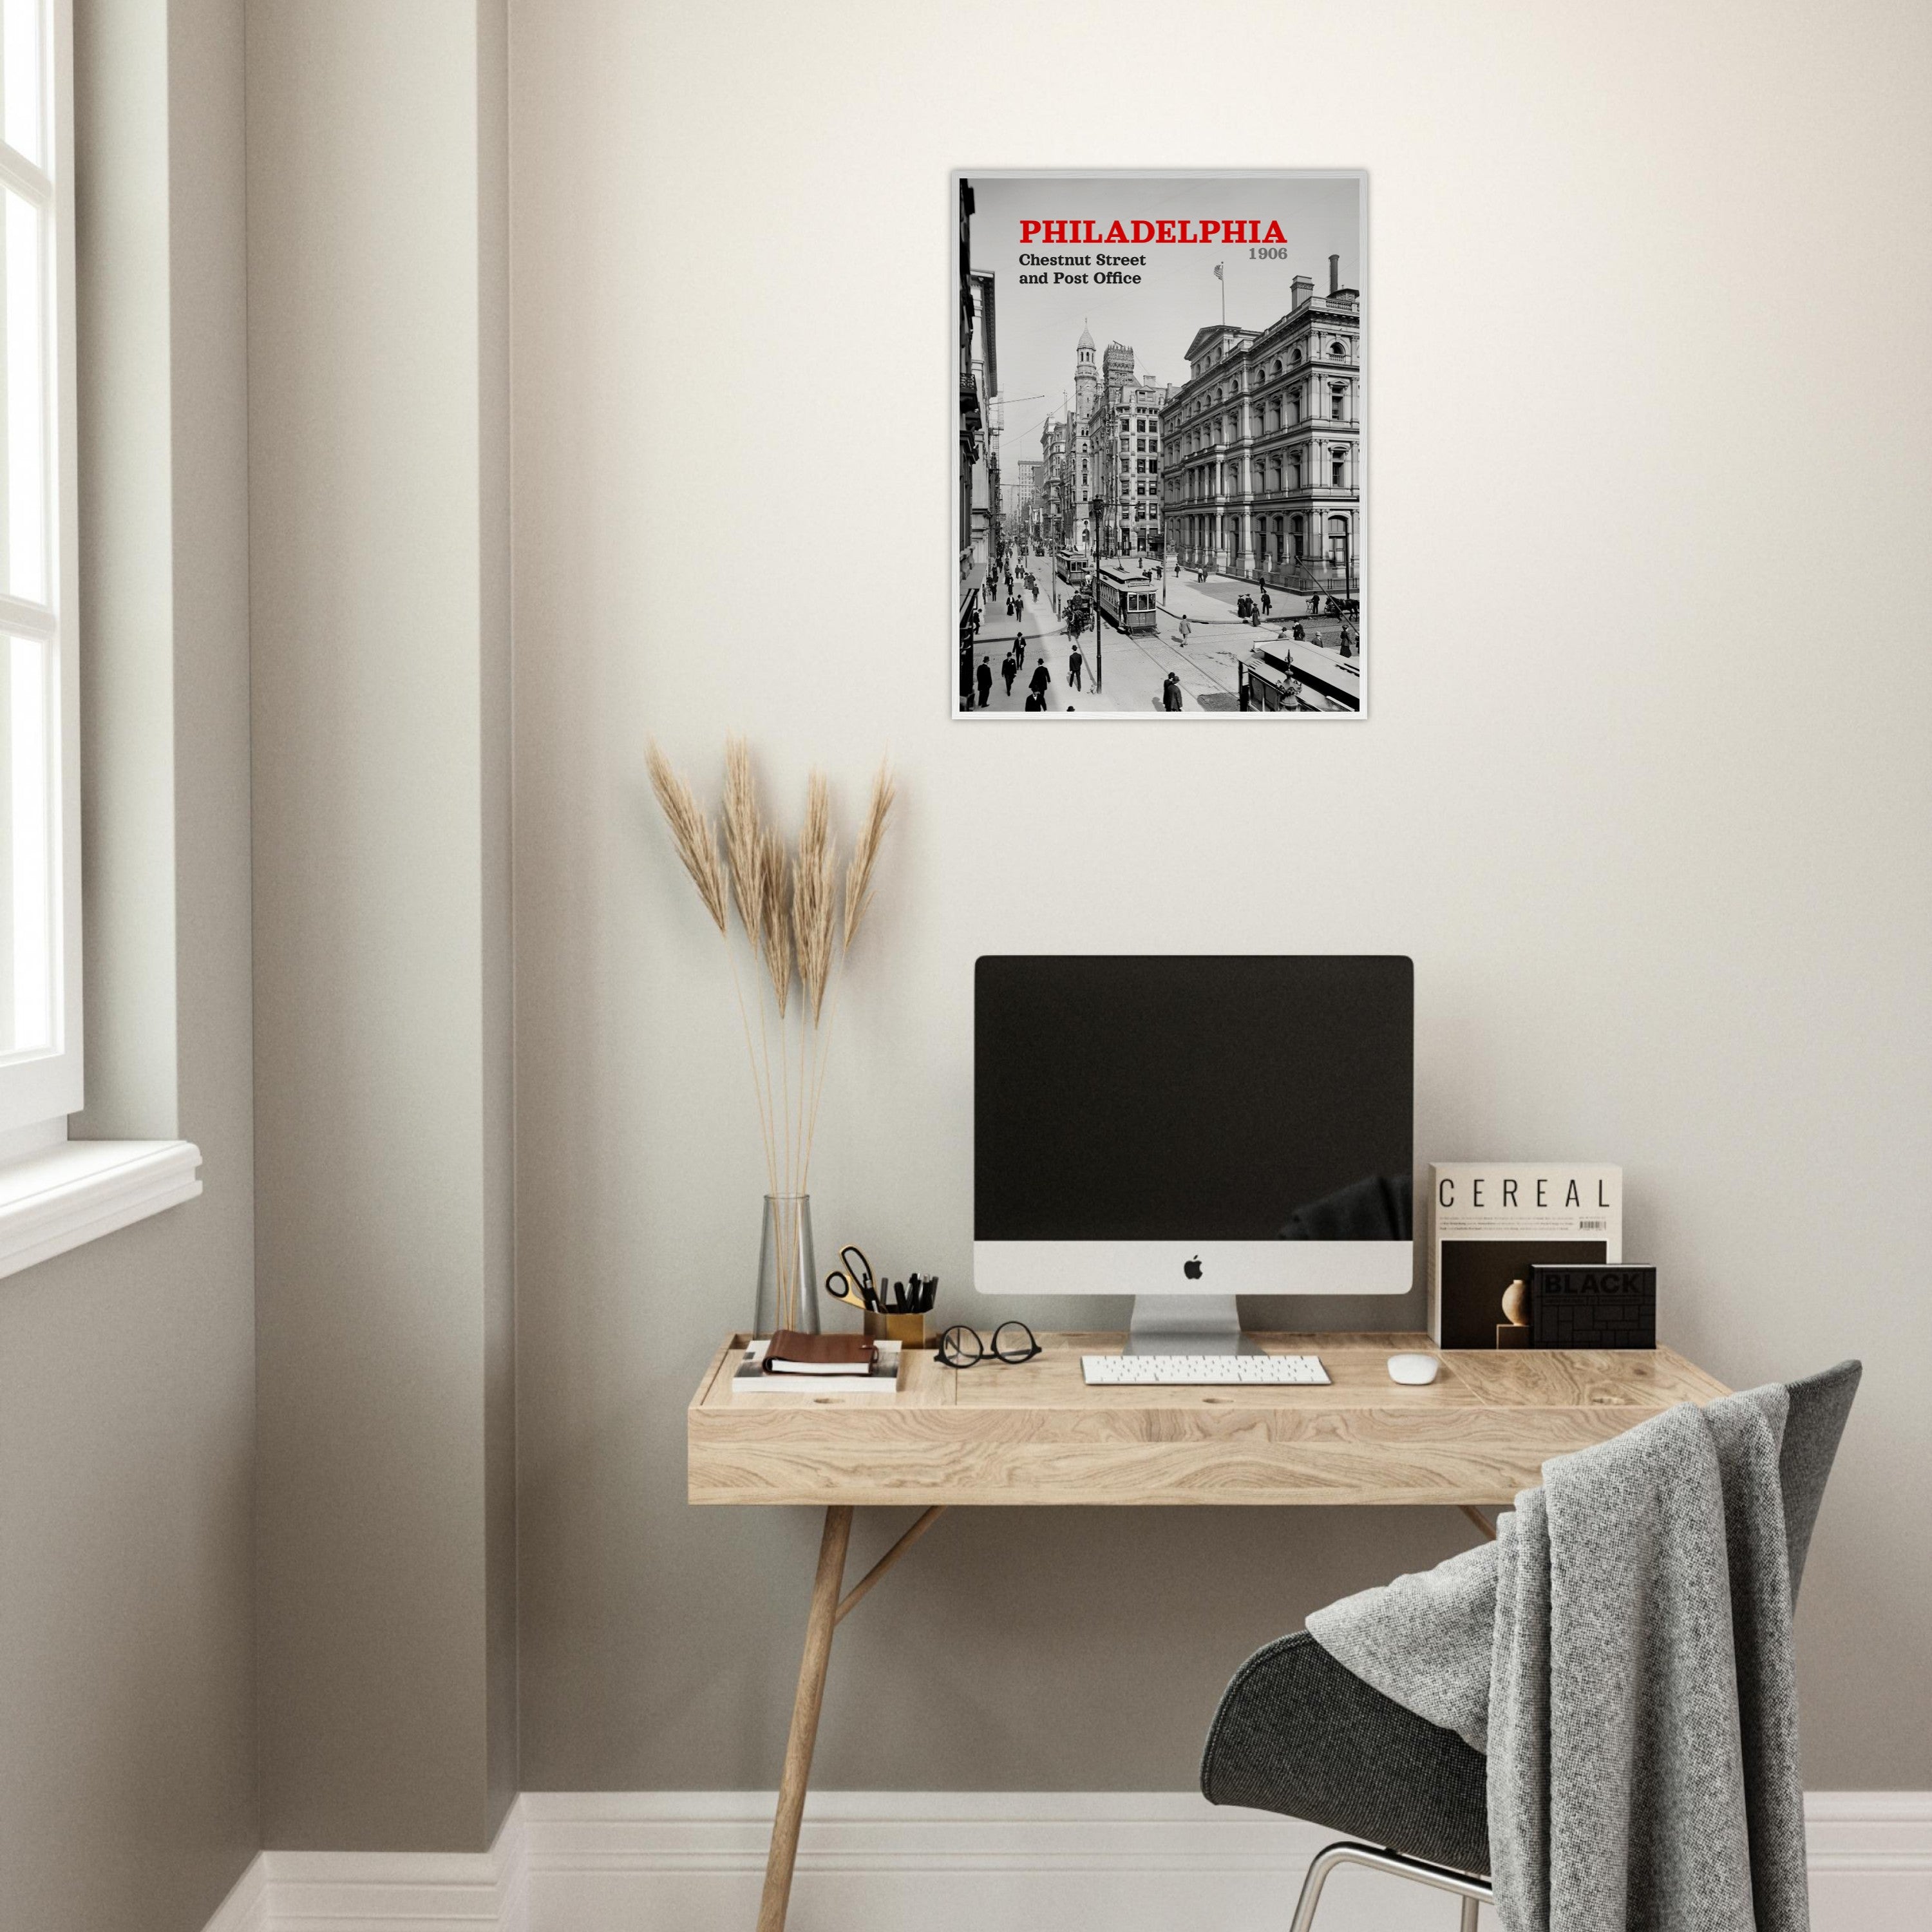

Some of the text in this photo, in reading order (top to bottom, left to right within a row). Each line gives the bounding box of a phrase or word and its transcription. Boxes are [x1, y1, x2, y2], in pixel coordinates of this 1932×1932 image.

[1019, 220, 1287, 243] PHILADELPHIA
[1019, 253, 1146, 266] Chestnut Street
[1249, 247, 1288, 260] 1906
[1019, 271, 1142, 285] and Post Office
[1439, 1178, 1610, 1208] CEREAL
[1544, 1273, 1640, 1294] BLACK
